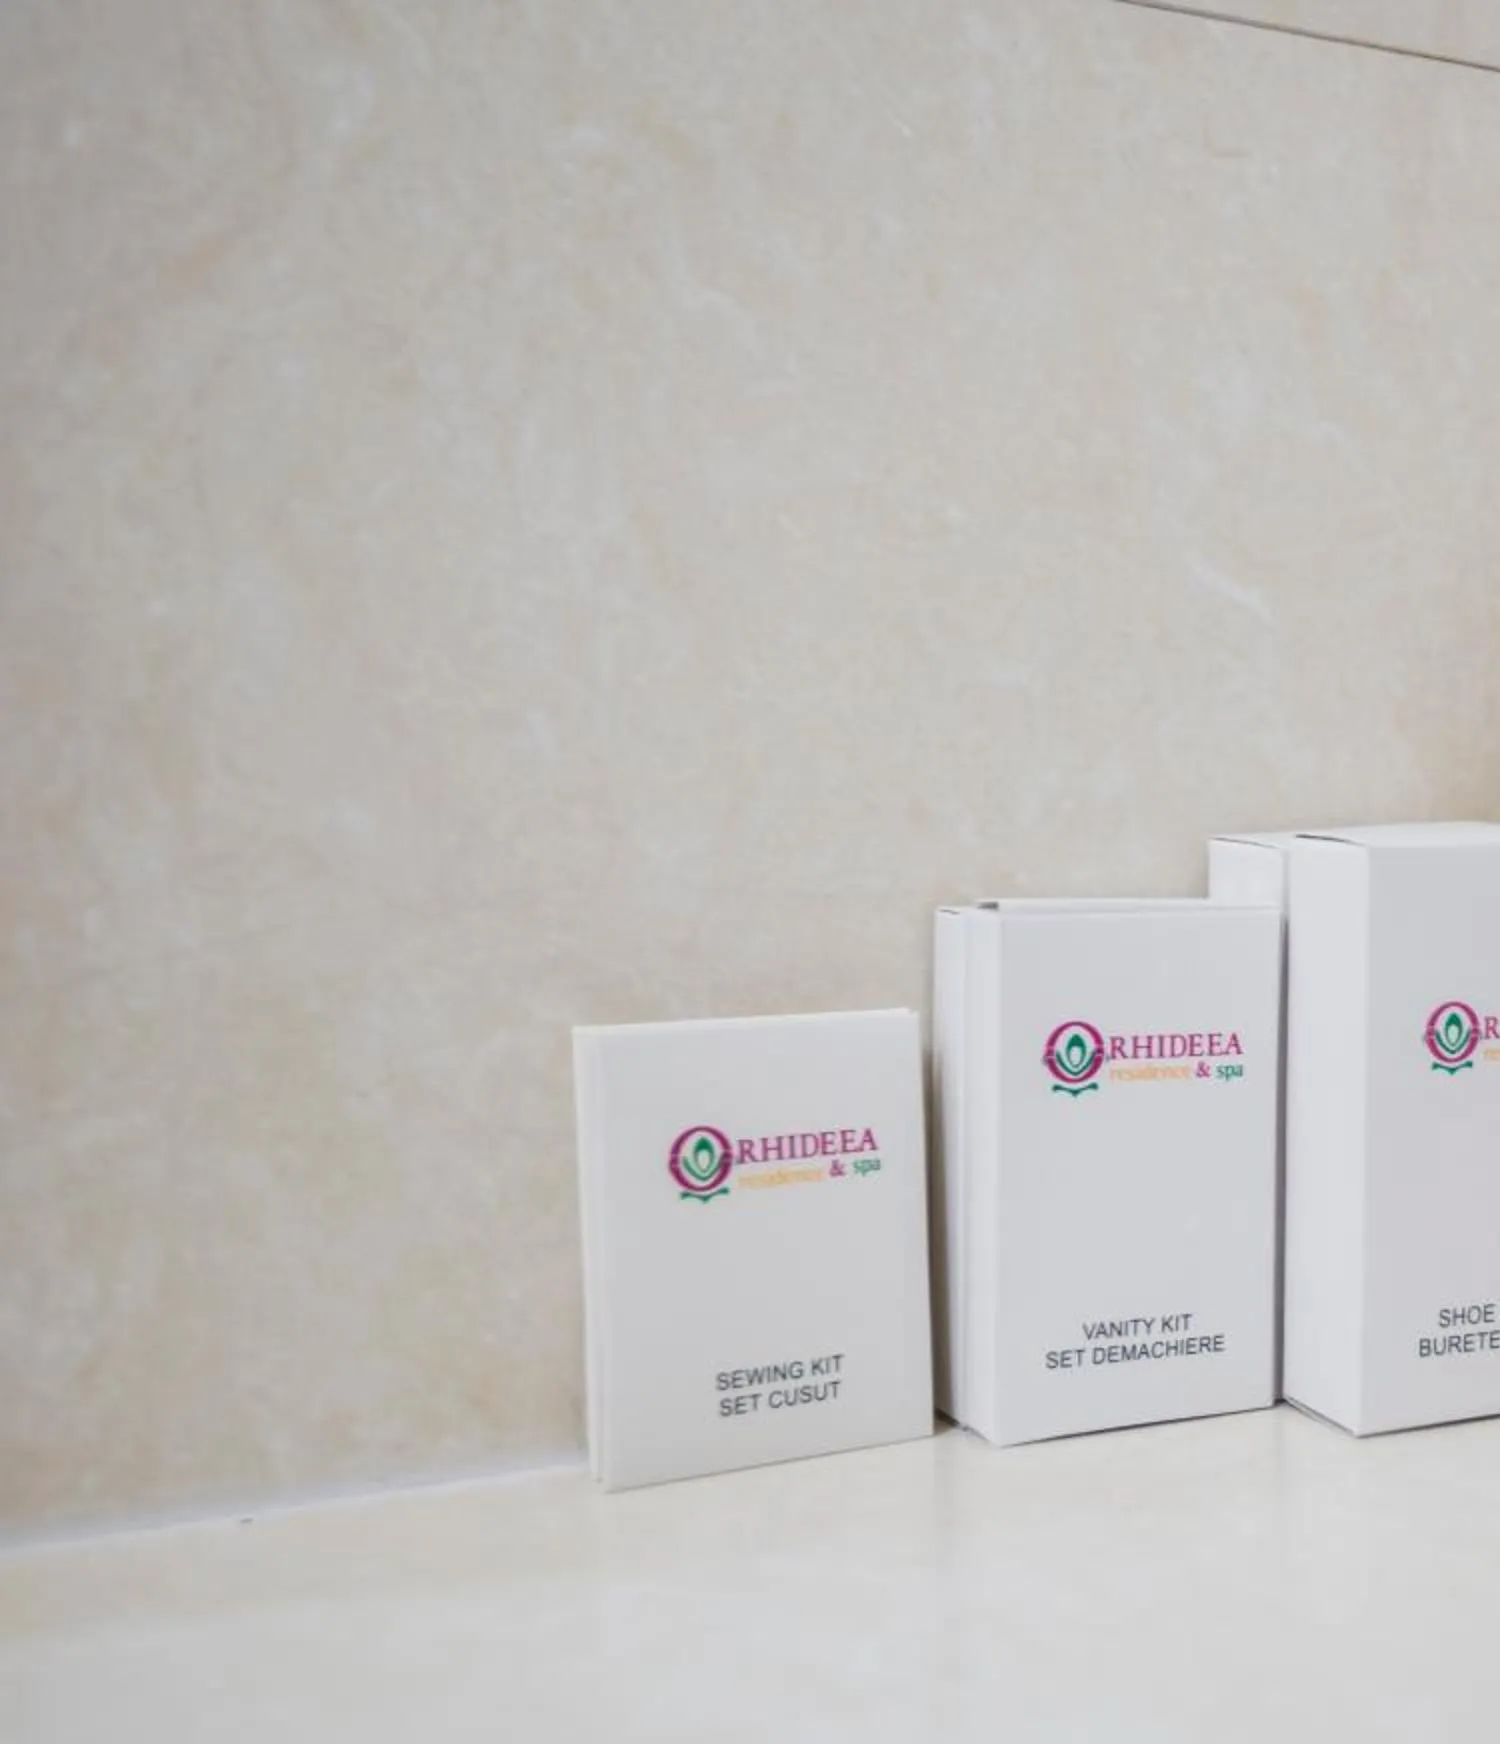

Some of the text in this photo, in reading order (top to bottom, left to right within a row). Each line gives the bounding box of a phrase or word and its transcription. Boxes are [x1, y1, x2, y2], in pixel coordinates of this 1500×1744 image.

[1042, 1021, 1244, 1085] ORHIDEEA
[1195, 1062, 1211, 1079] &
[1216, 1064, 1244, 1081] spa
[668, 1125, 879, 1193] ORHIDEEA
[829, 1160, 846, 1178] &
[1082, 1313, 1193, 1340] VANITY KIT
[1438, 1303, 1496, 1329] SHOE
[1045, 1334, 1226, 1369] SET DEMACHIERE
[1419, 1329, 1500, 1358] BURETE
[716, 1353, 845, 1391] SEWING KIT
[719, 1380, 842, 1417] SET CUSUT
